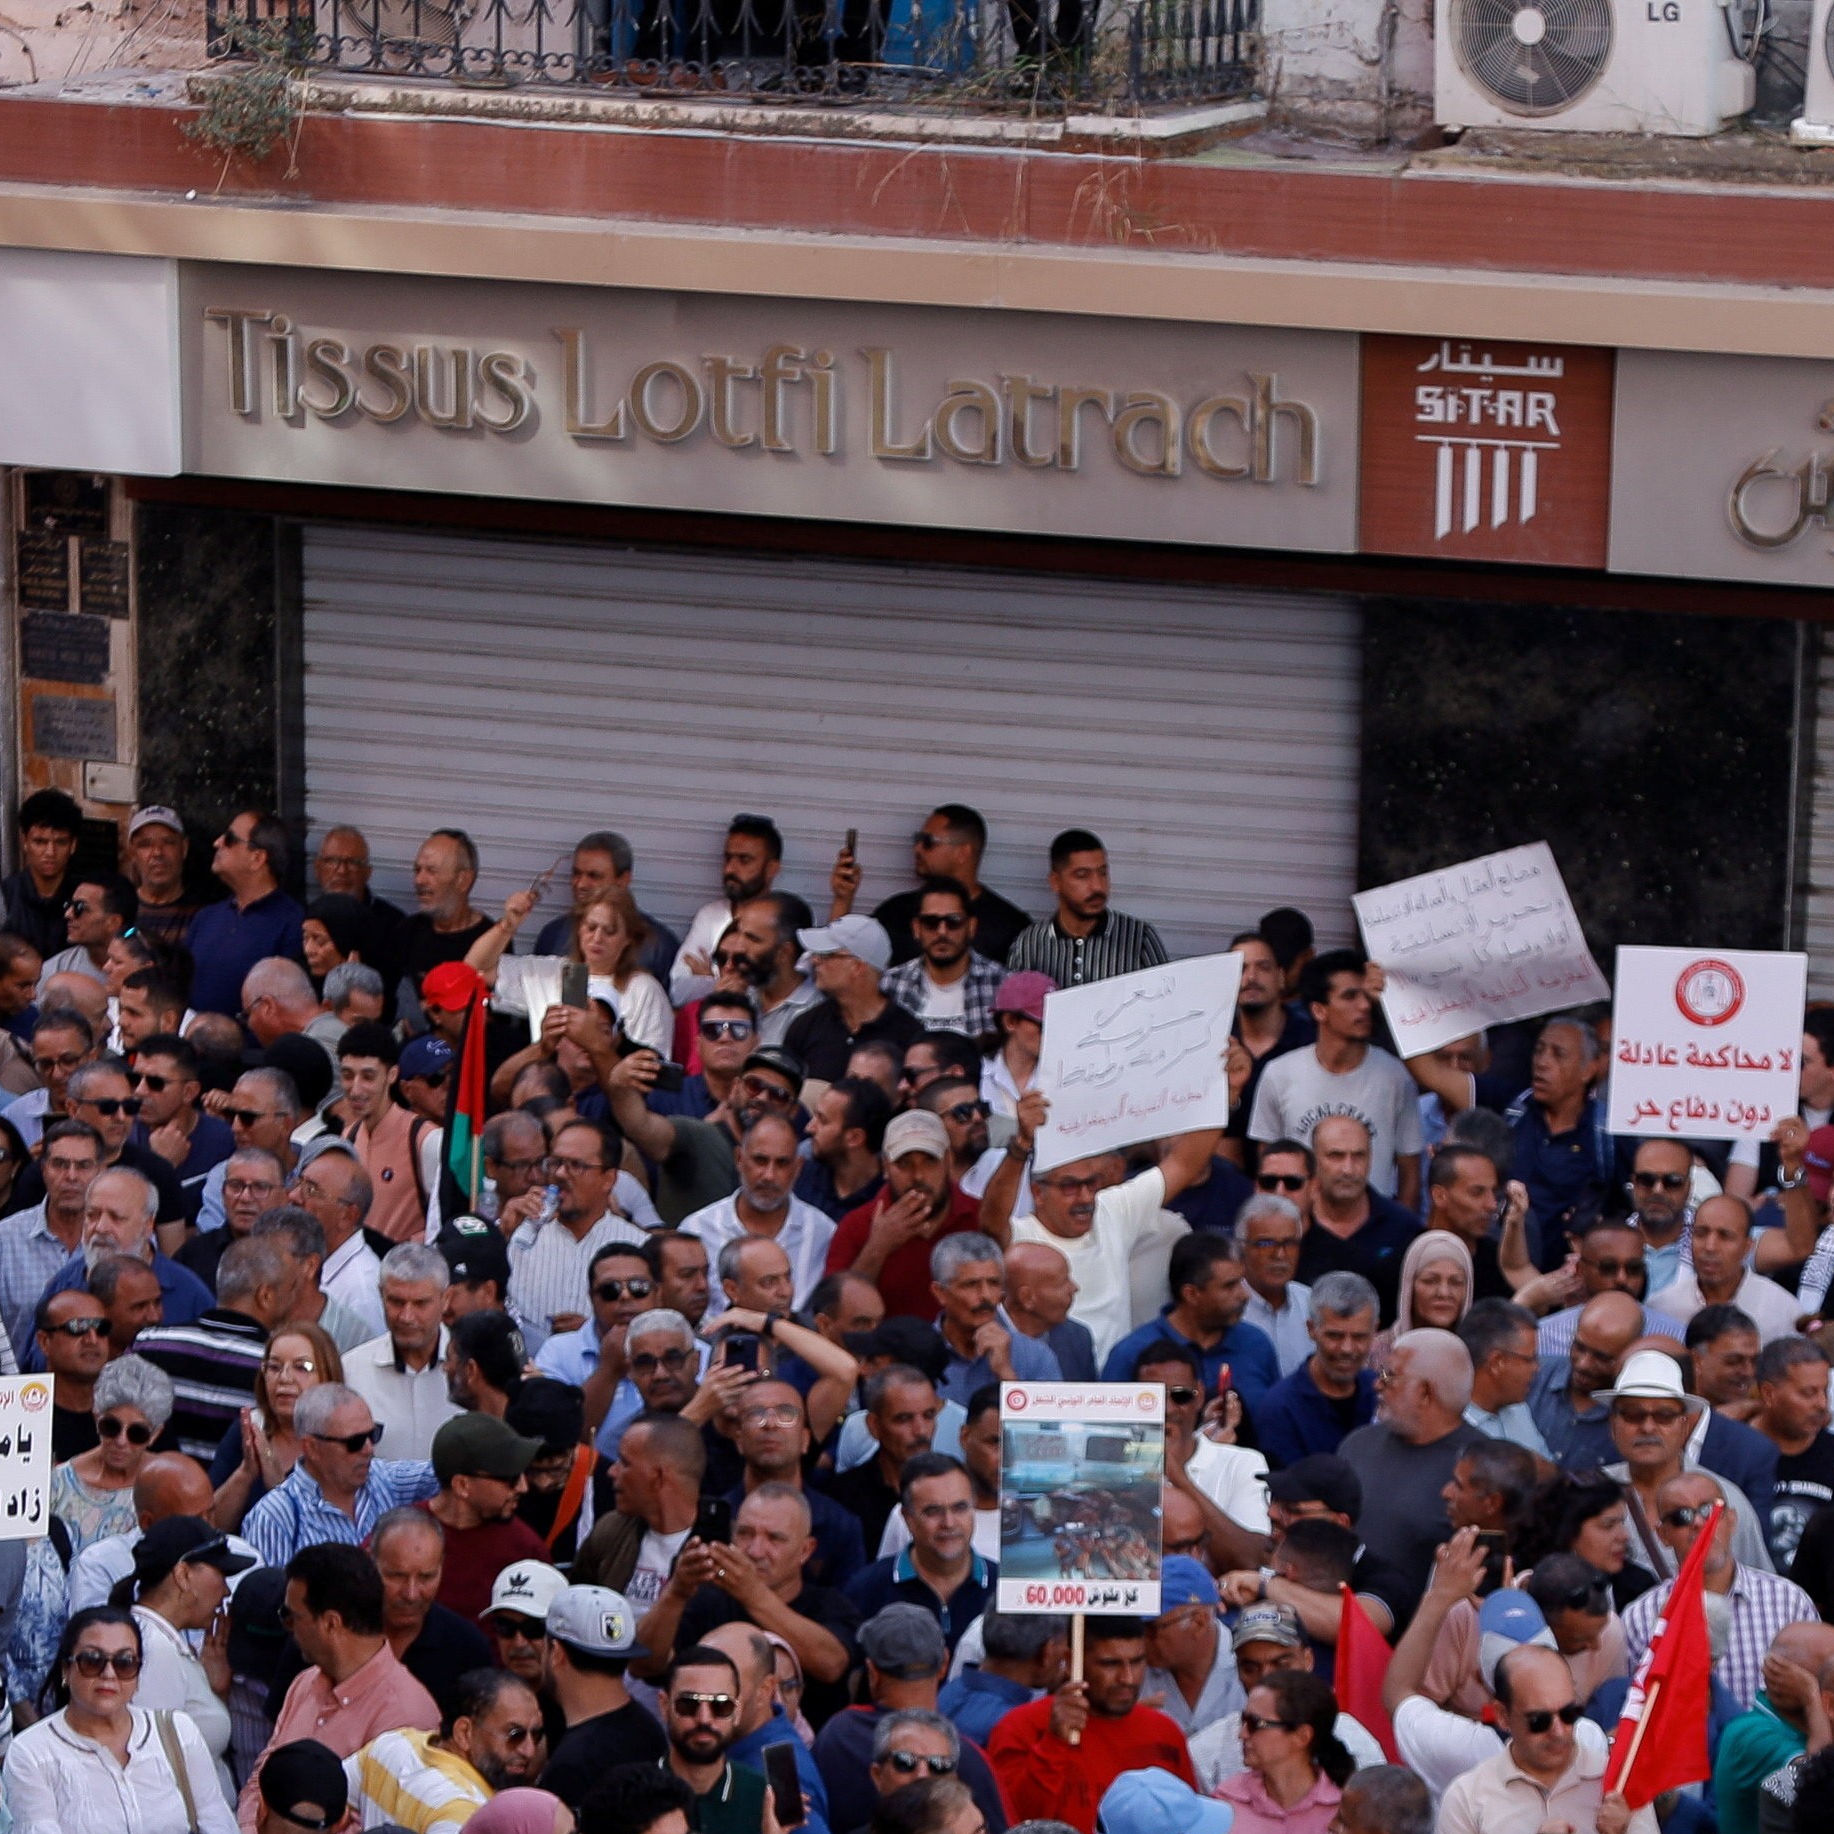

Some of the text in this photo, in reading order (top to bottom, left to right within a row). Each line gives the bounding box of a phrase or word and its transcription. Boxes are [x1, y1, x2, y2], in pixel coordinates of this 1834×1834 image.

[1648, 3, 1680, 21] LG
[204, 306, 1323, 490] Tissus Lotfi Latrach
[1618, 1039, 1793, 1072] لا محاكمة عادلة
[1628, 1097, 1770, 1132] دون دفاع حر
[16, 1423, 32, 1463] يا
[7, 1488, 41, 1523] زاد
